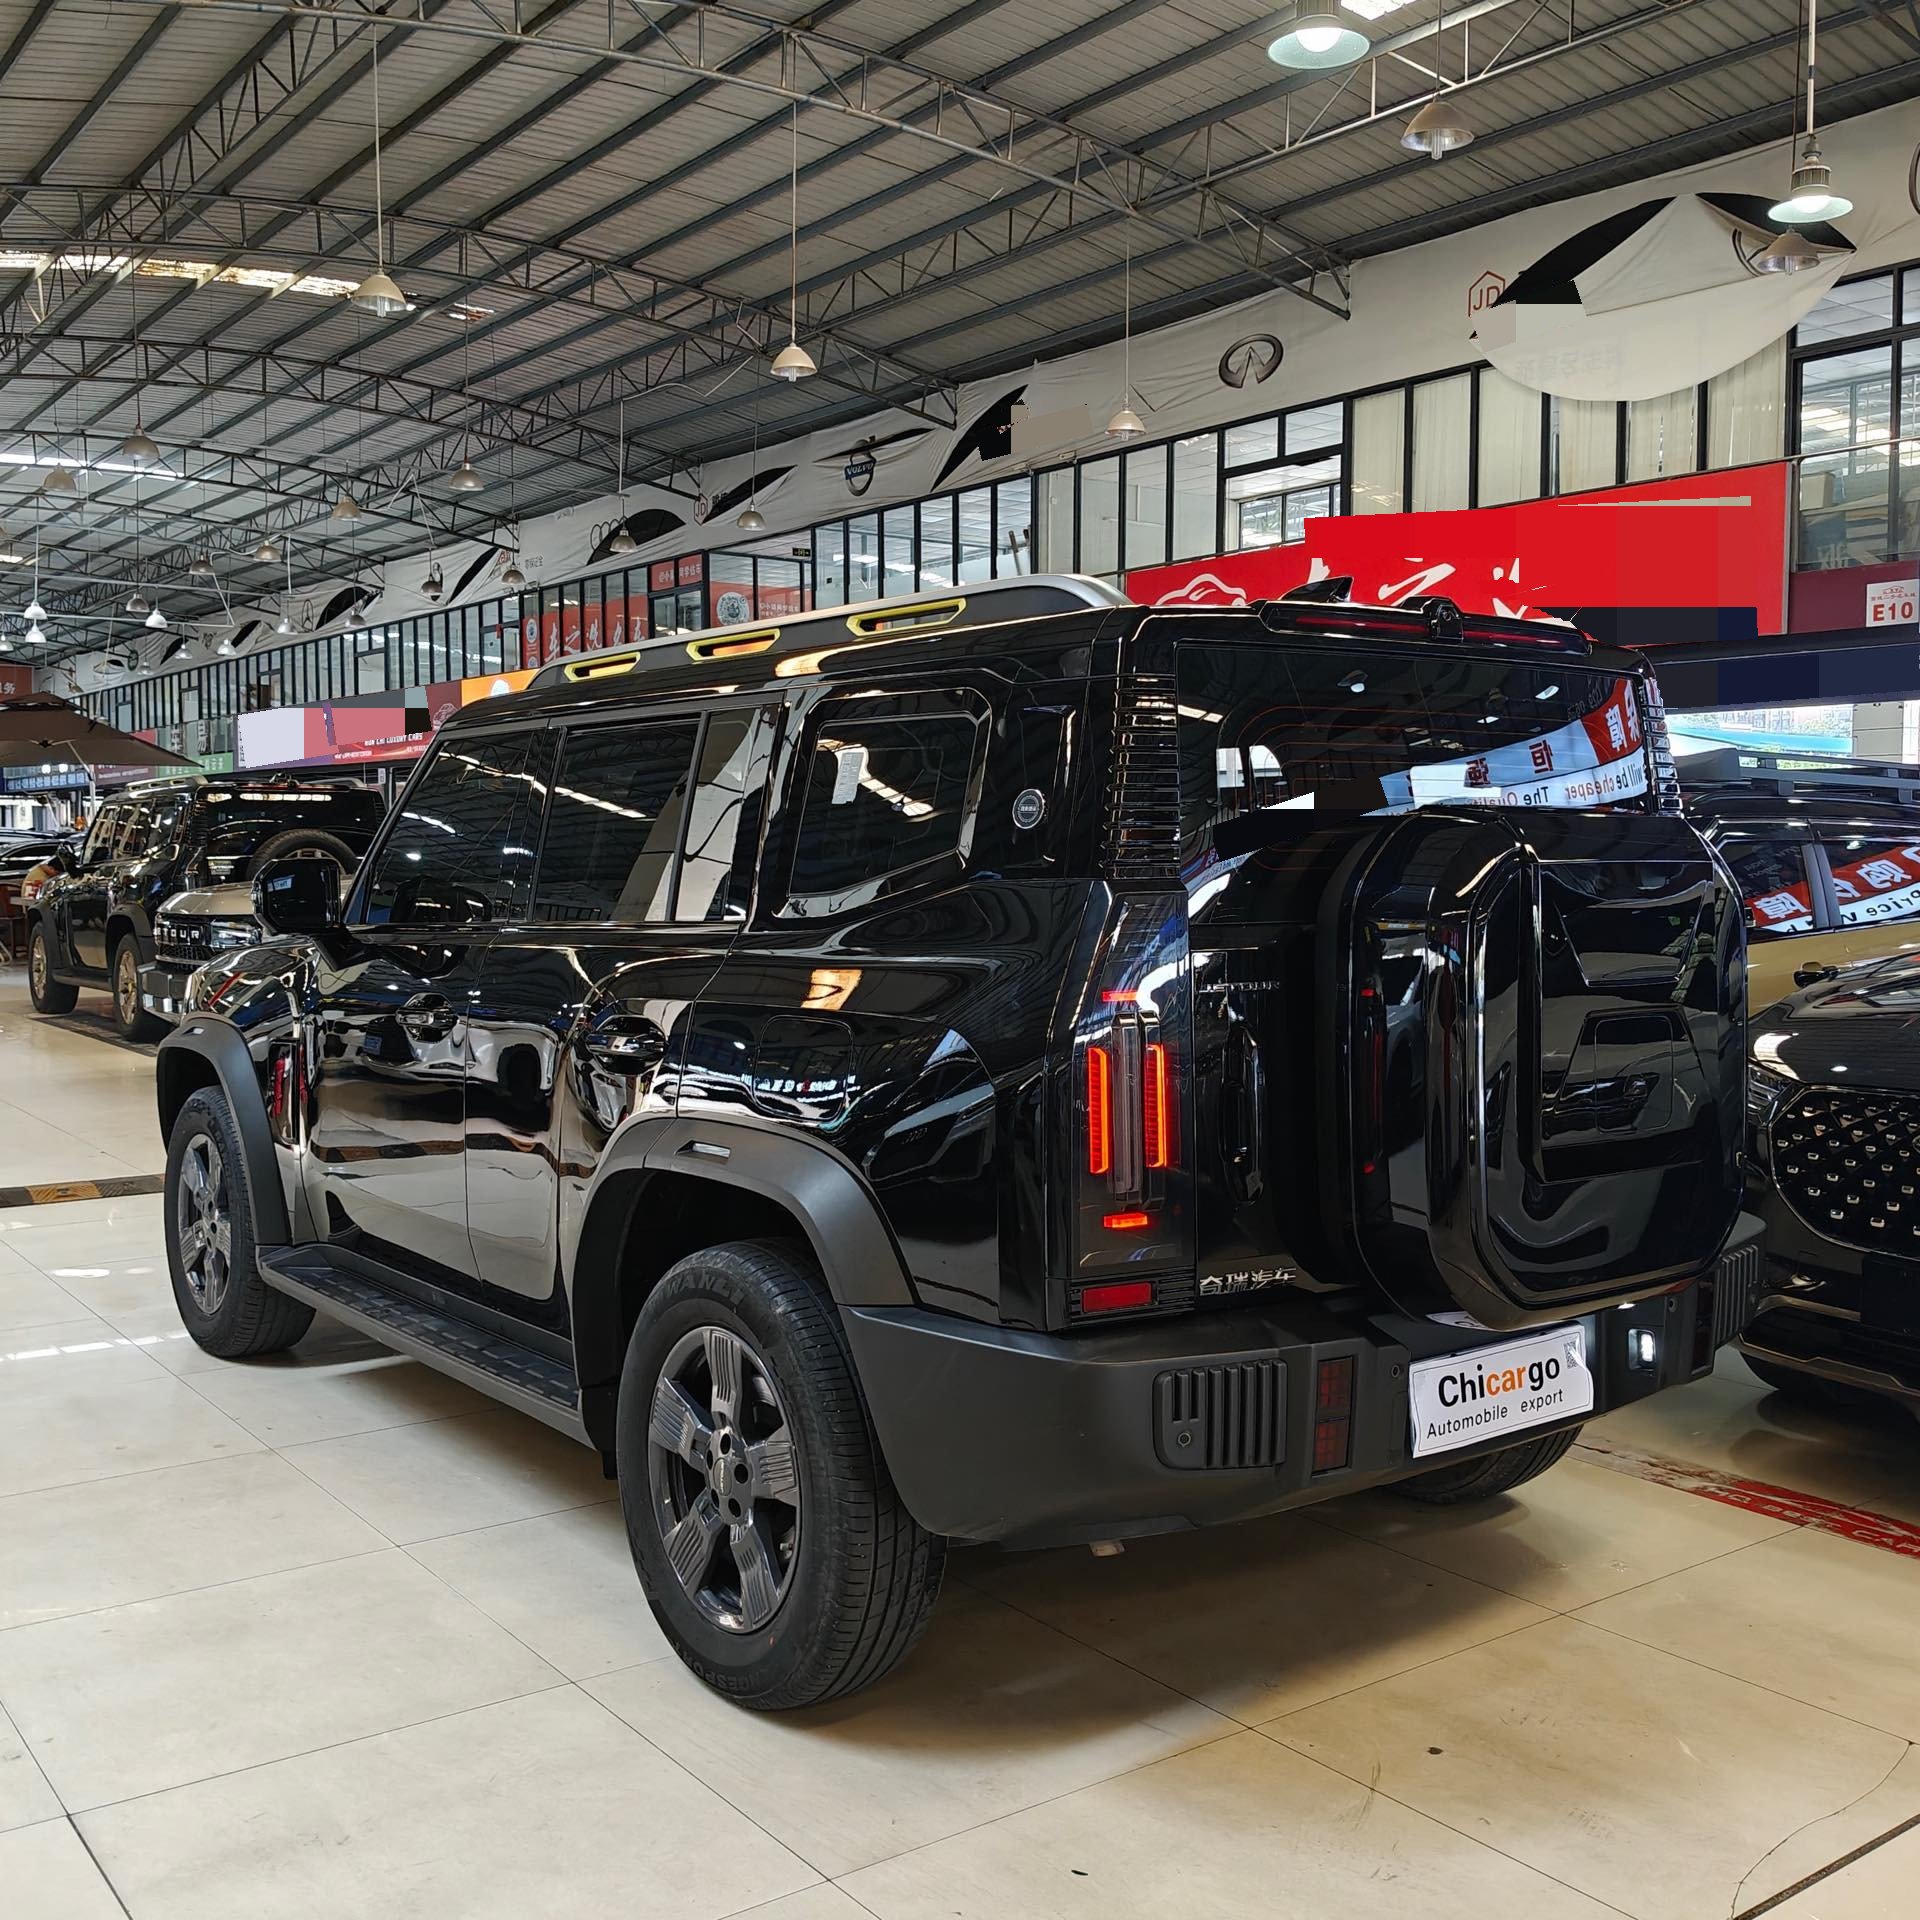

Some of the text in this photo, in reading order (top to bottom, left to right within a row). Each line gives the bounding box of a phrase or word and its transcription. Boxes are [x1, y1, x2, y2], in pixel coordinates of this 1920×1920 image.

[1473, 285, 1501, 311] JD
[846, 462, 874, 475] VOLVO
[1873, 601, 1914, 622] E10
[1200, 1267, 1297, 1296] 奇瑞汽车
[1438, 1357, 1560, 1407] Chicargo
[1427, 1389, 1563, 1438] Automobile export
